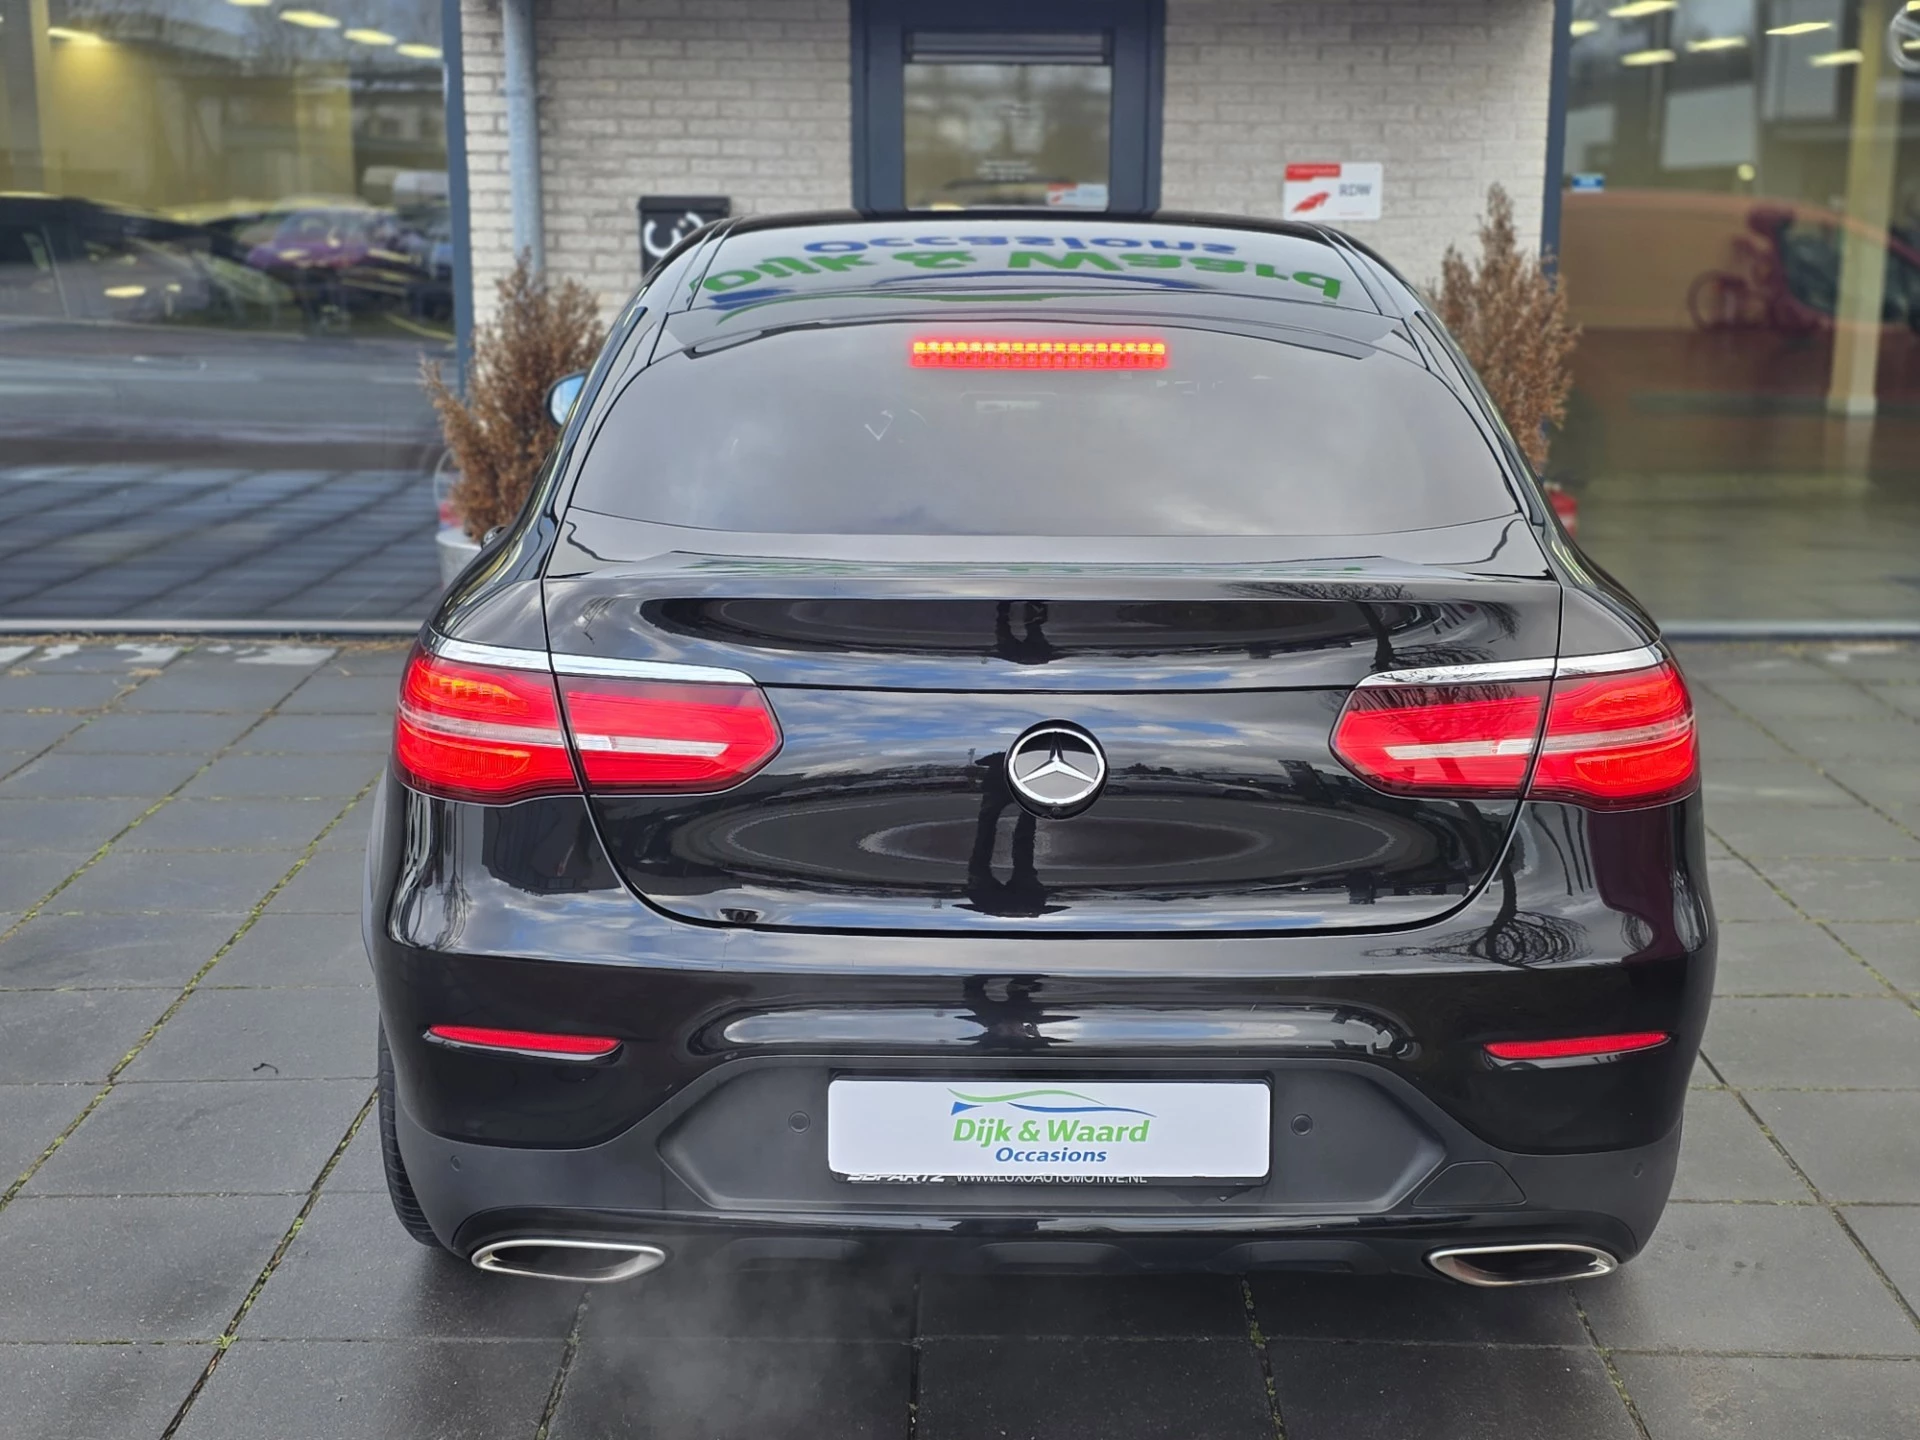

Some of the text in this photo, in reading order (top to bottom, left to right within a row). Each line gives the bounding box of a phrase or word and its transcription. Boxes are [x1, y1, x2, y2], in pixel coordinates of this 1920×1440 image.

[1339, 183, 1372, 197] RDW
[953, 1118, 1150, 1146] Dijk & Waard
[995, 1147, 1107, 1163] Occasions
